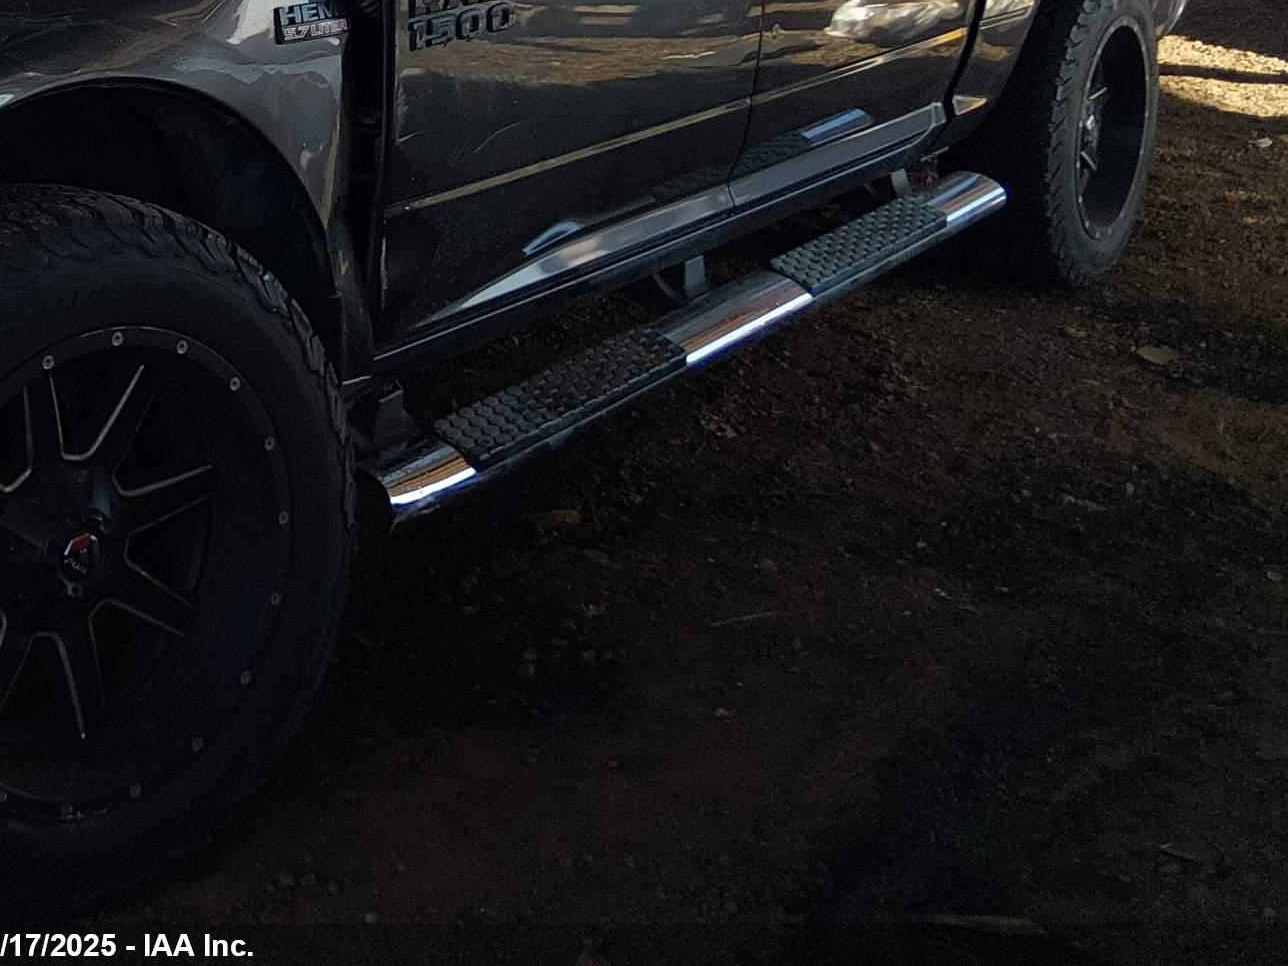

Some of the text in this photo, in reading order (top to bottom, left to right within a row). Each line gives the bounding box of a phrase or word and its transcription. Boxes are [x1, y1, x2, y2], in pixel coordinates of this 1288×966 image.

[276, 0, 347, 26] HEM
[409, 1, 516, 51] 1500
[283, 18, 348, 41] 5.7 LITER
